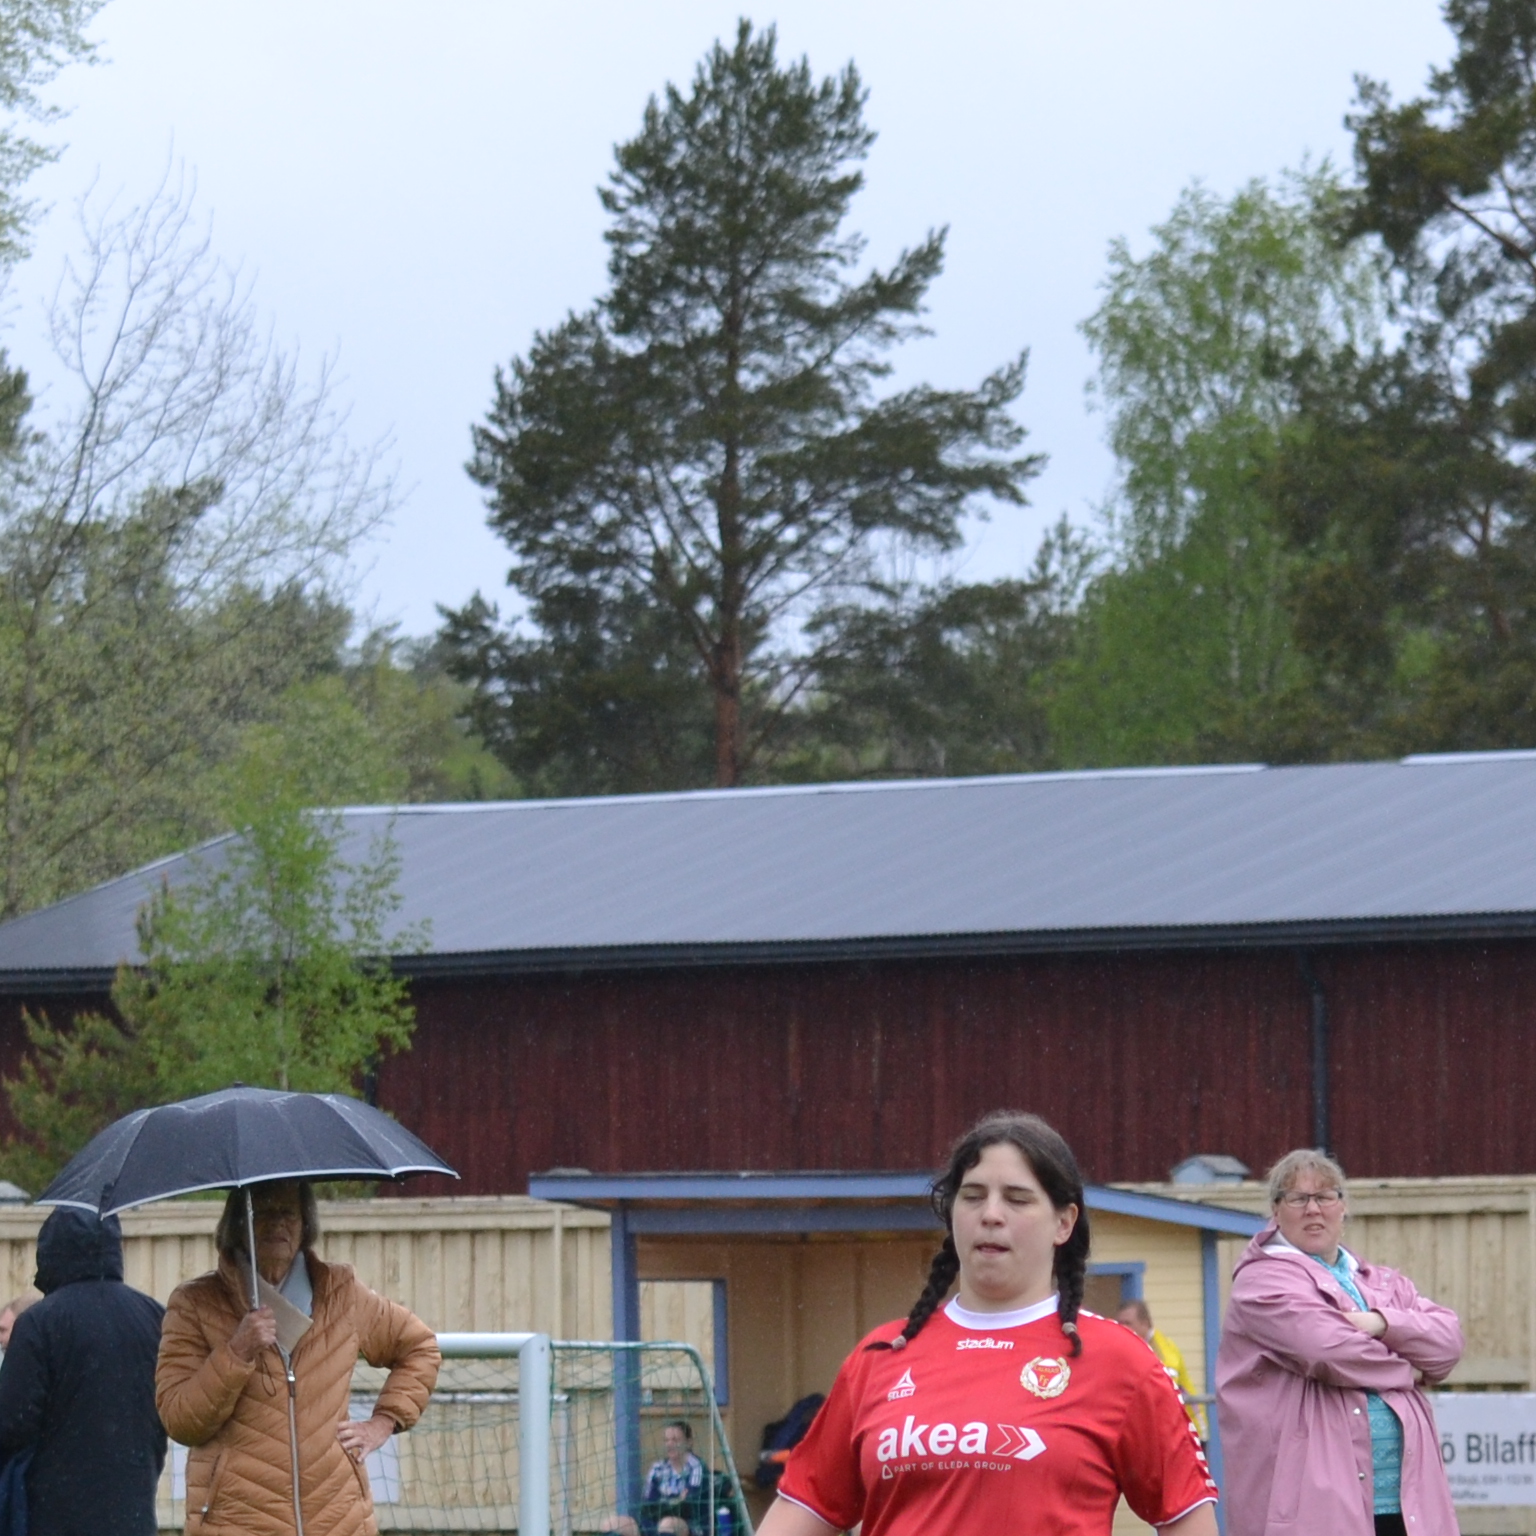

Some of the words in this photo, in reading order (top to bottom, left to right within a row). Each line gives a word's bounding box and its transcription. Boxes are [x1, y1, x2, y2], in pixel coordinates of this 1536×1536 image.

[956, 1337, 1014, 1350] stadium
[887, 1388, 915, 1401] SELECT
[877, 1415, 989, 1462] akea
[894, 1464, 916, 1474] PART
[921, 1462, 934, 1471] OF
[939, 1461, 970, 1470] ELEDA
[974, 1461, 1011, 1472] GROUP
